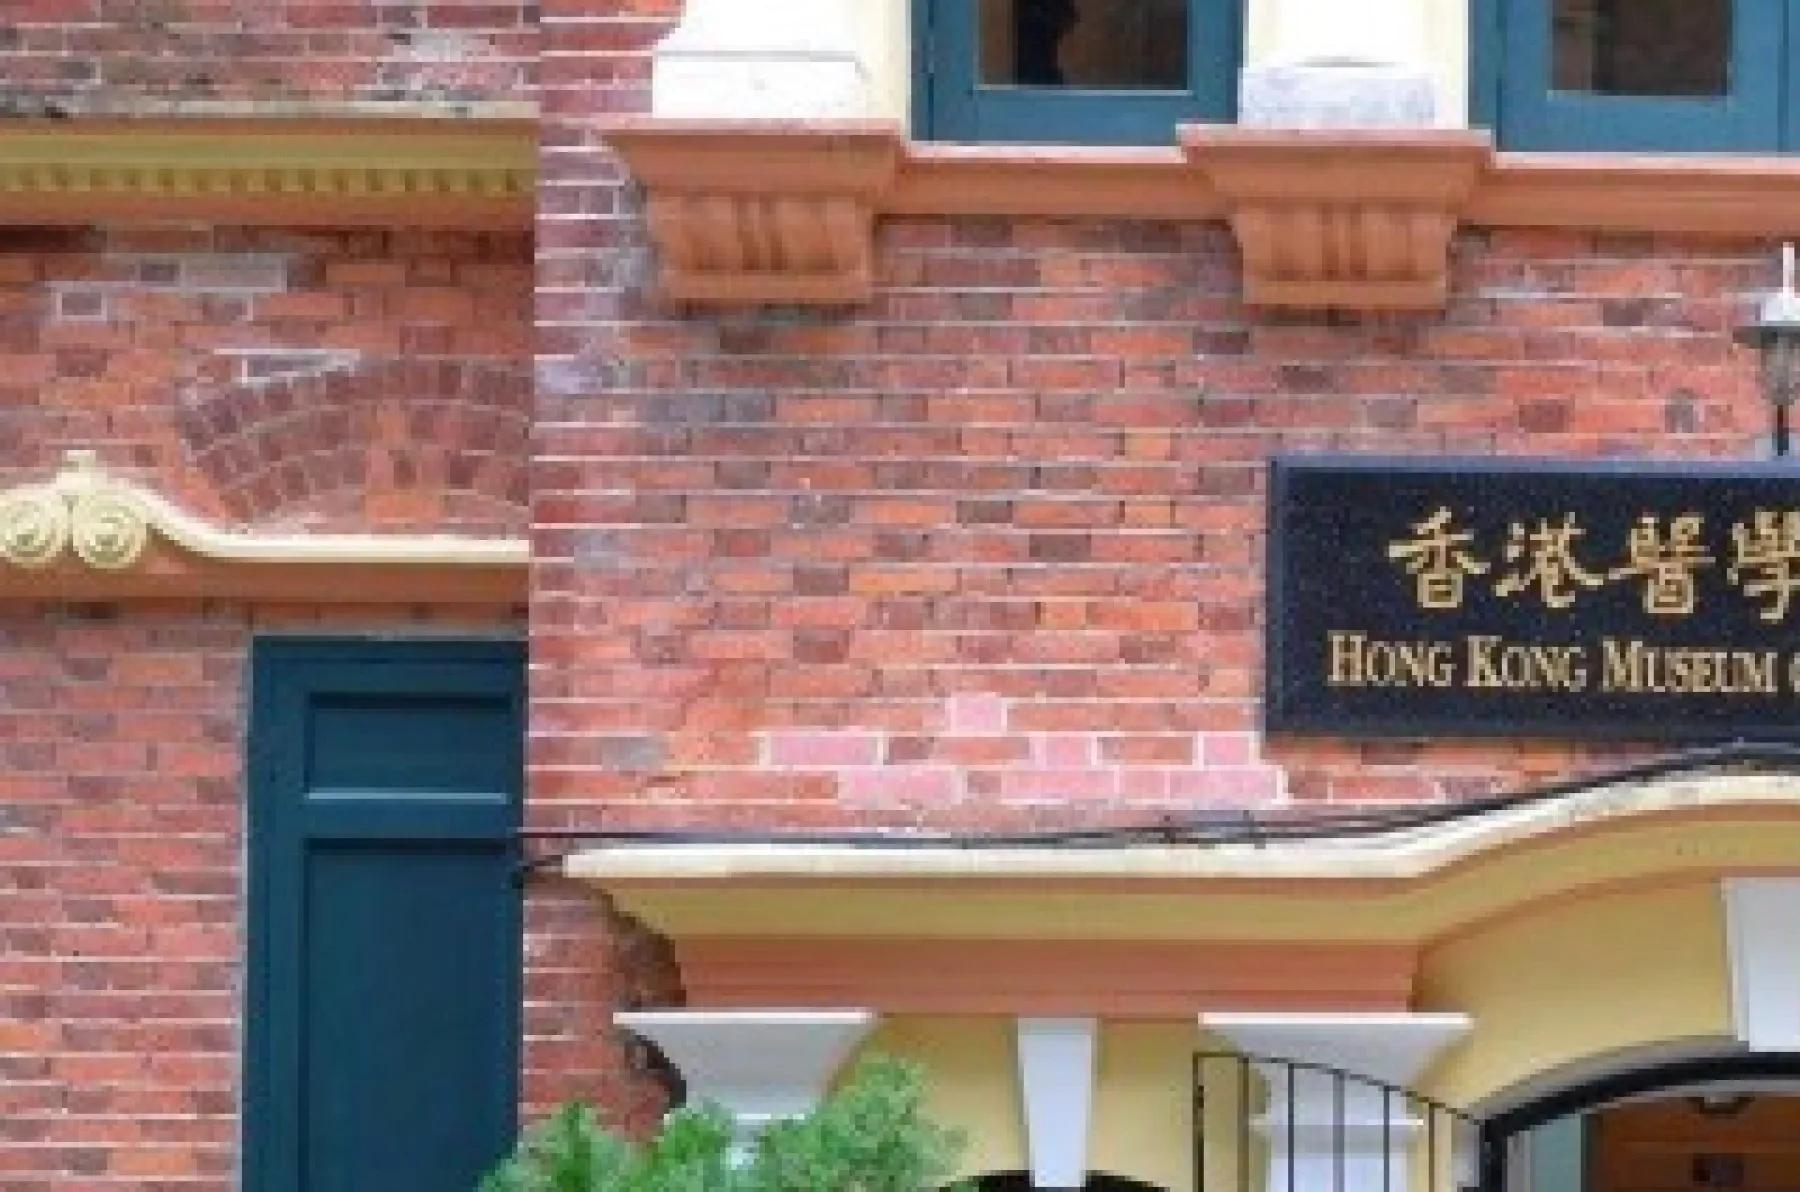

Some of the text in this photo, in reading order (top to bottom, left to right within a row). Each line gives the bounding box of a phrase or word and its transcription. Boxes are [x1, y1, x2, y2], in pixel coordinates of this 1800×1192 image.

[1328, 632, 1455, 687] HONG
[1465, 638, 1586, 690] KONG
[1603, 640, 1777, 692] MUSEUM
